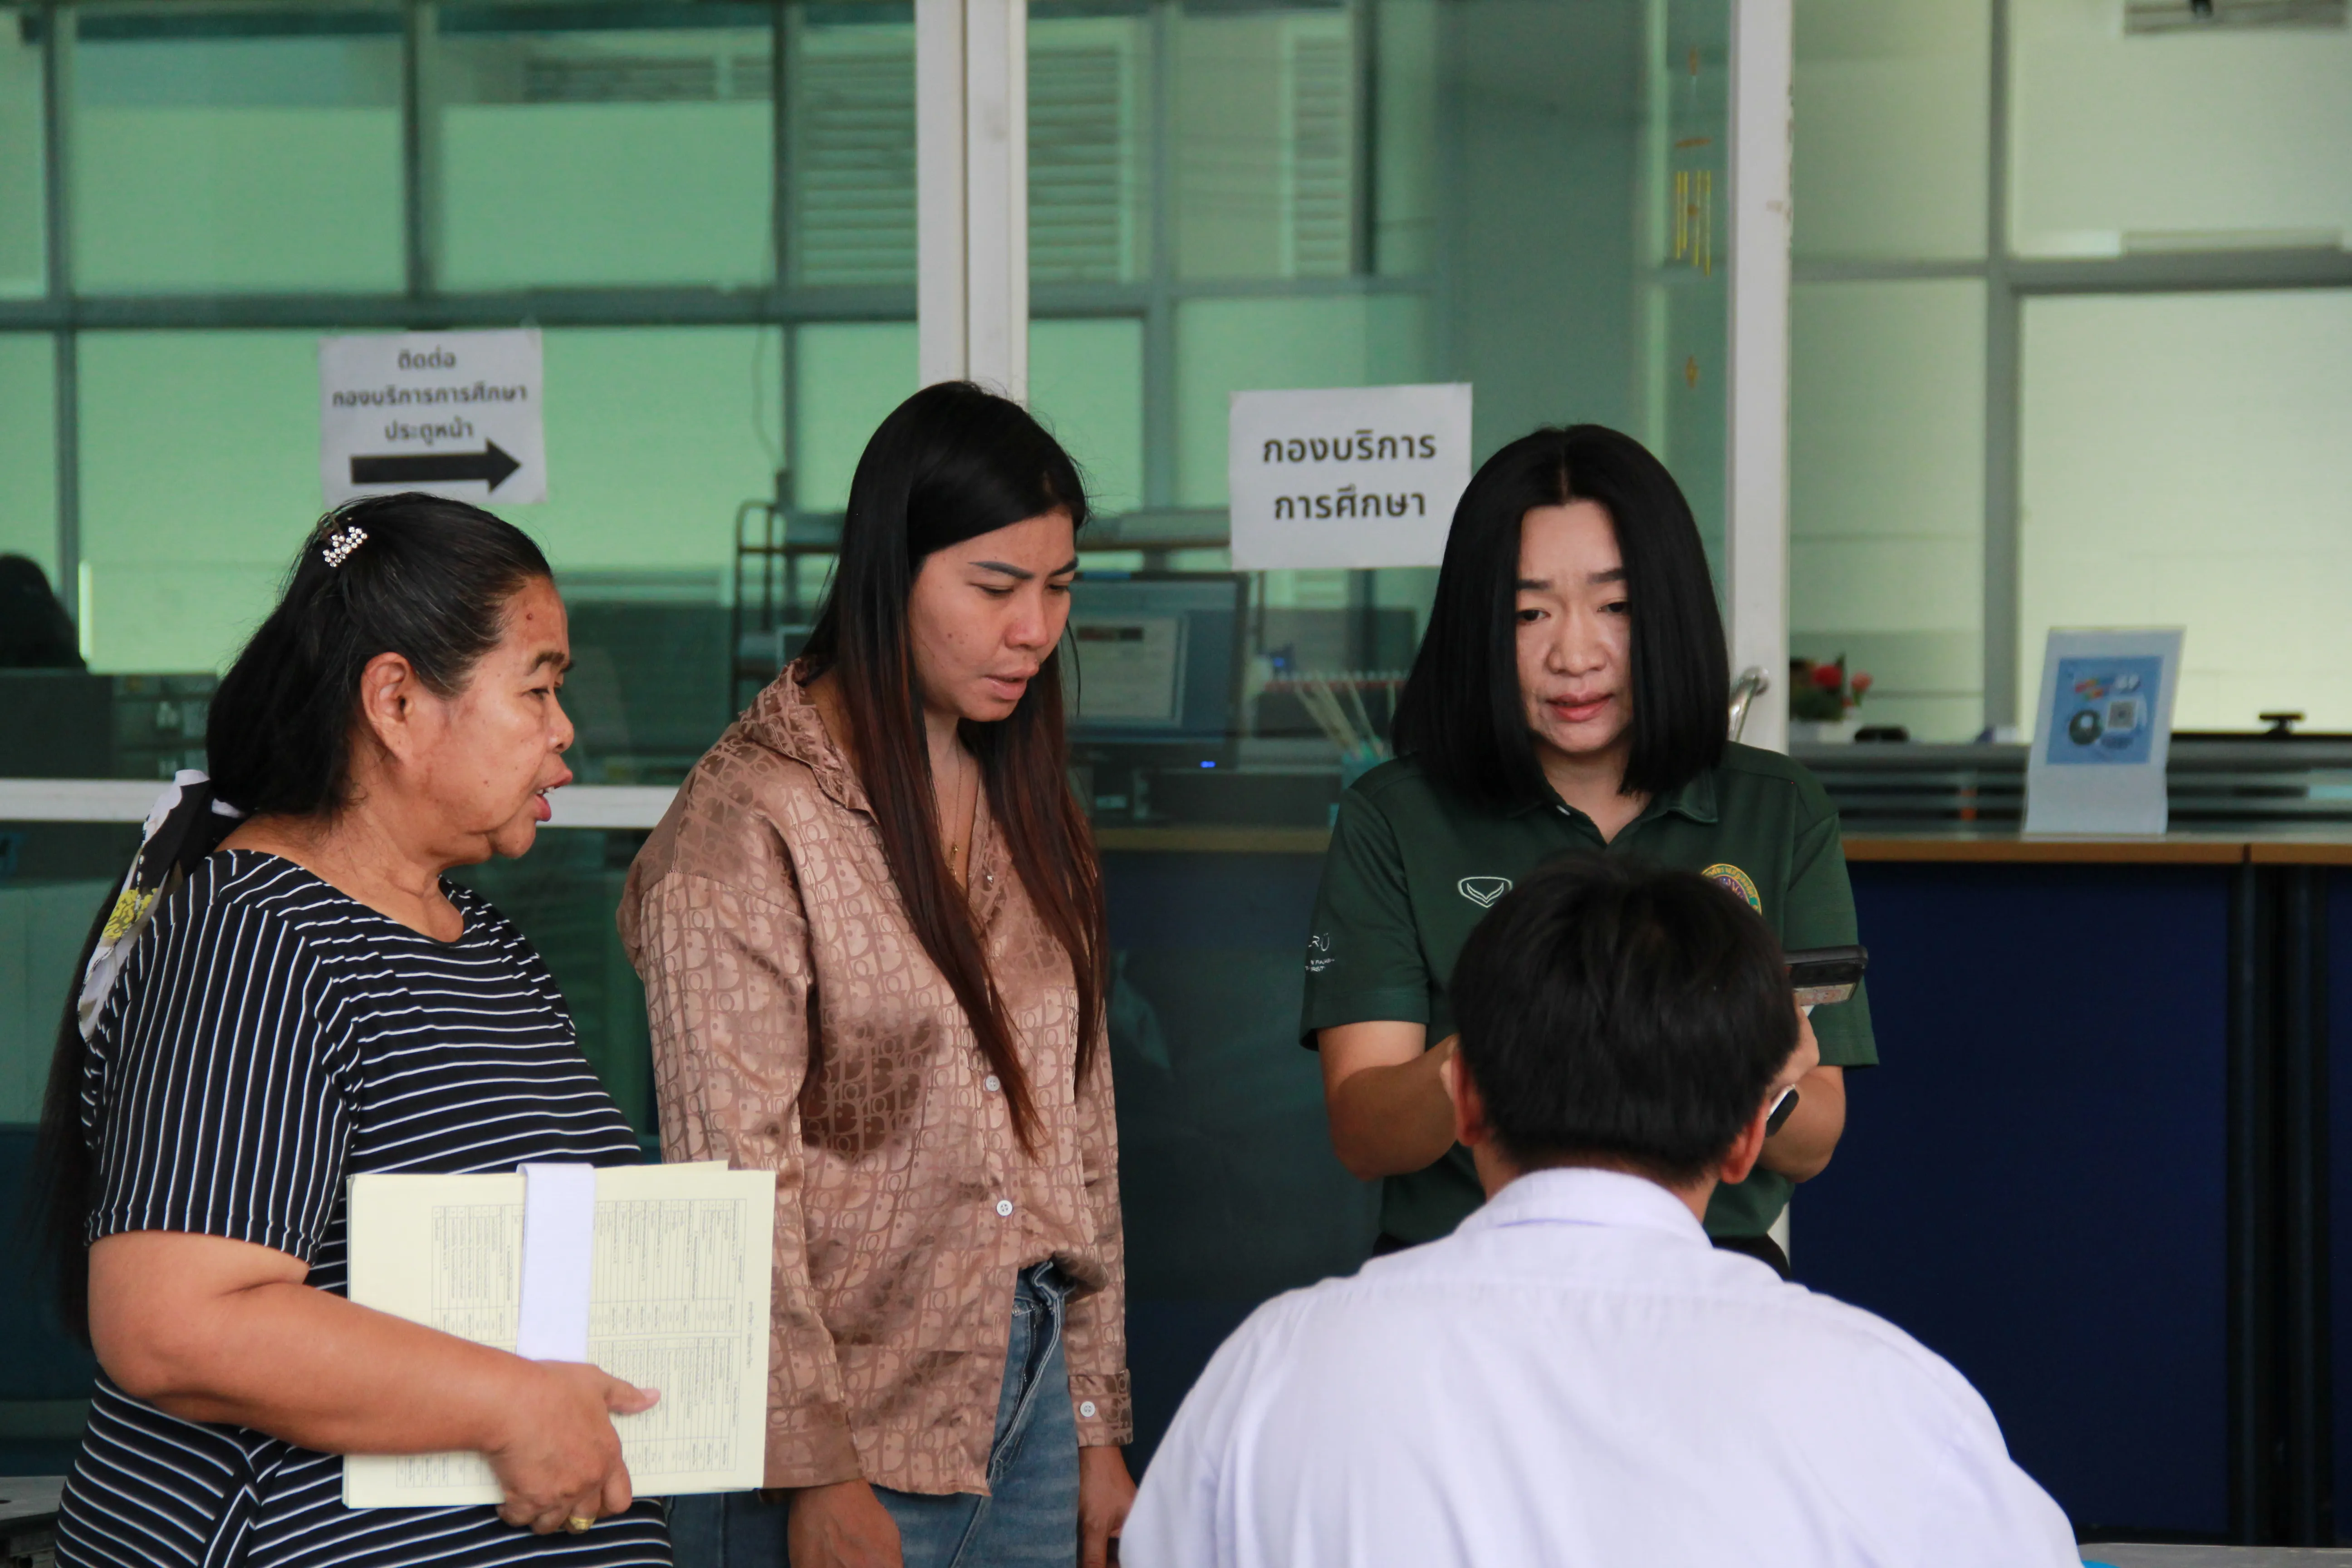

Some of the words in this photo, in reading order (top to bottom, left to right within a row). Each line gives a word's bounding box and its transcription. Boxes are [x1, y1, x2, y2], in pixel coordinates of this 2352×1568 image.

[398, 346, 456, 370] ติดต่อ
[333, 381, 528, 407] กองบริการการศึกษา
[384, 416, 474, 446] ประตูหน้า
[1263, 429, 1436, 464] กองบริการ
[1274, 483, 1426, 520] การศึกษา
